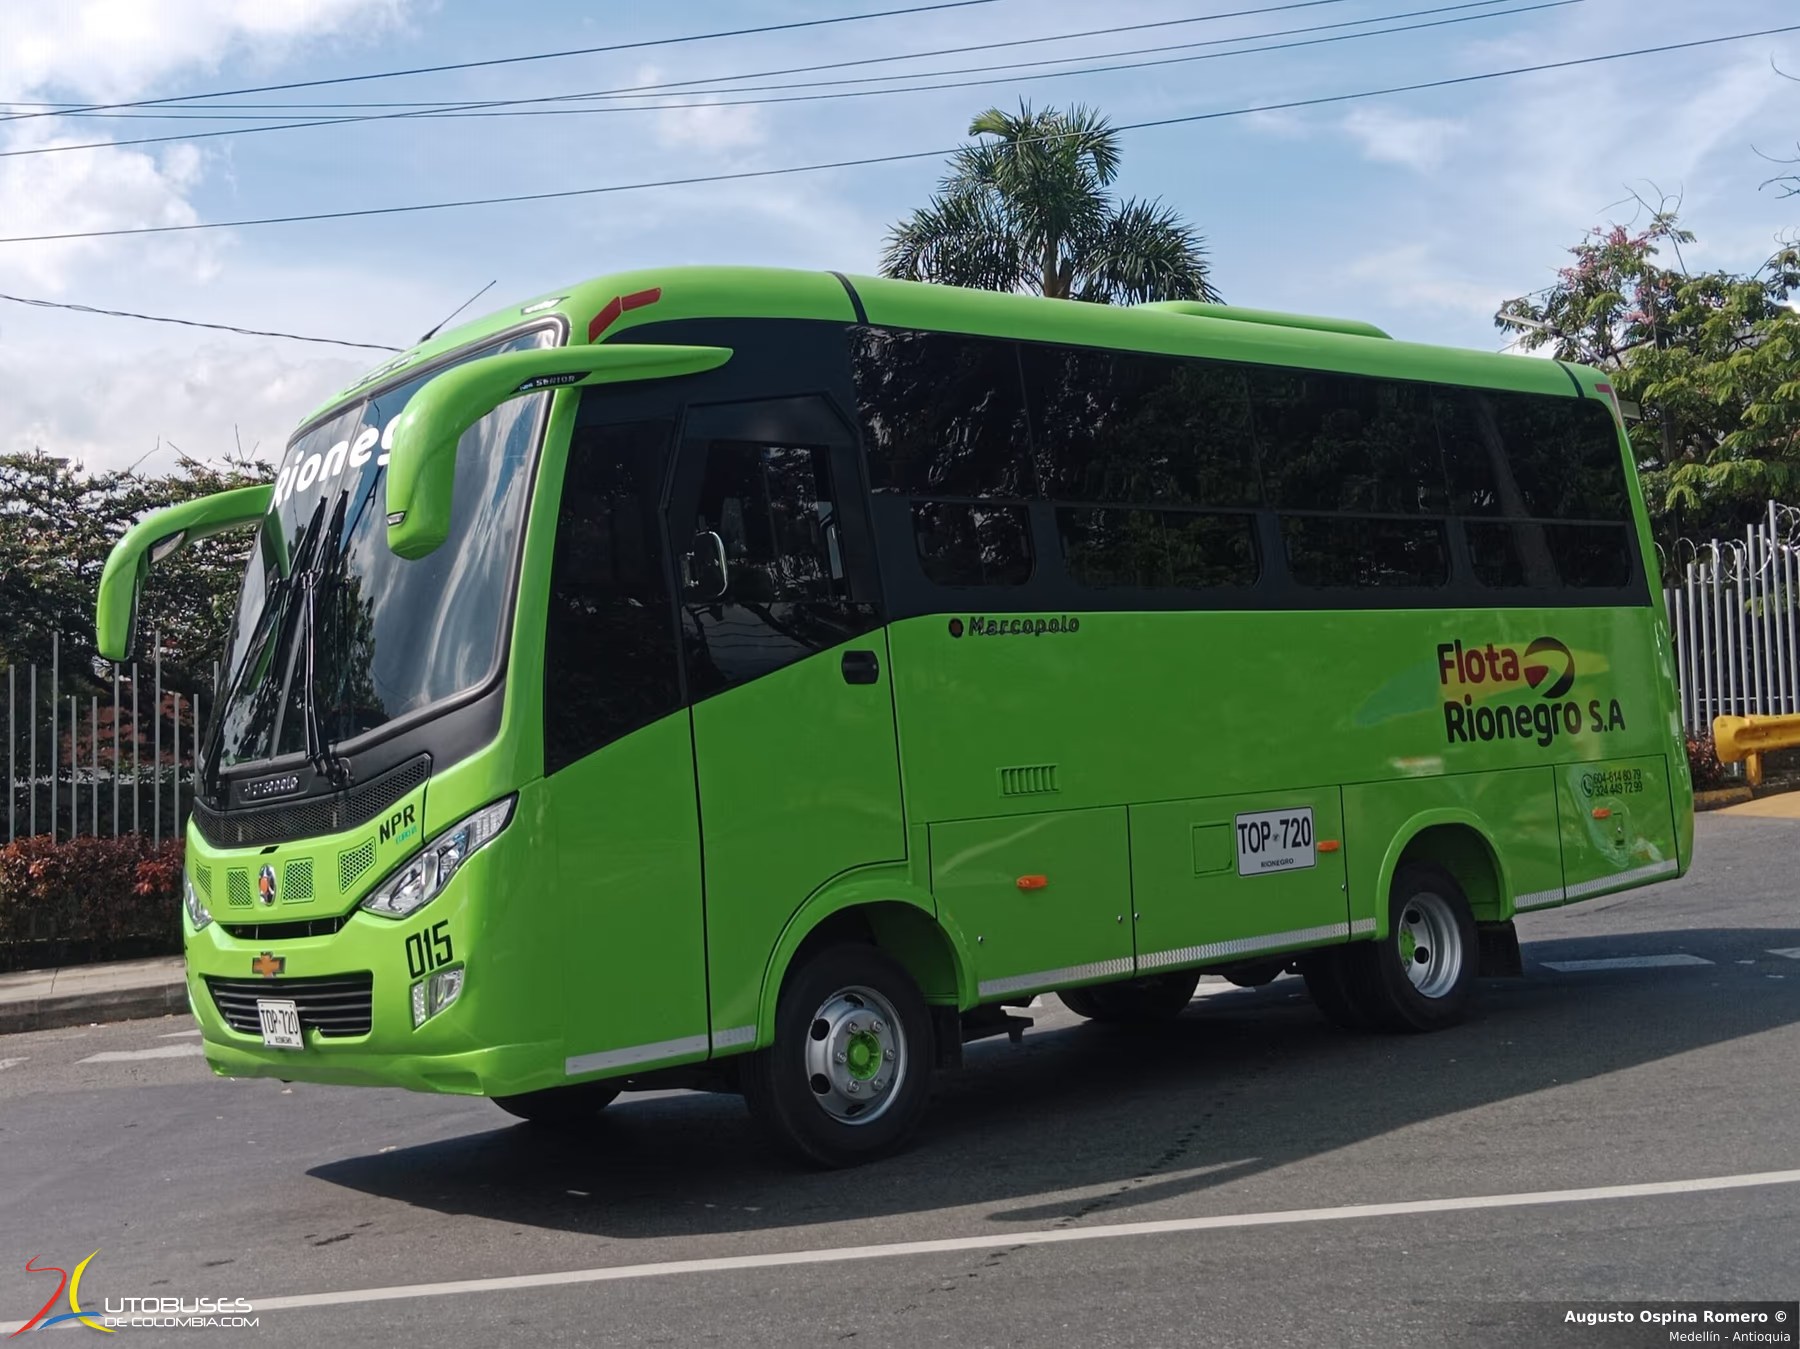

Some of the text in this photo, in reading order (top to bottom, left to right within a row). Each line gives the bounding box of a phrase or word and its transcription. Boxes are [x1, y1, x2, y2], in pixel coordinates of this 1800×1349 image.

[968, 615, 1080, 636] Marcopolo
[1437, 639, 1520, 685] Flota
[1444, 694, 1626, 747] Rionegro S.A
[379, 804, 415, 845] NPR
[1279, 816, 1311, 849] 720
[1260, 857, 1294, 868] RIONEGRO
[405, 918, 453, 980] 015
